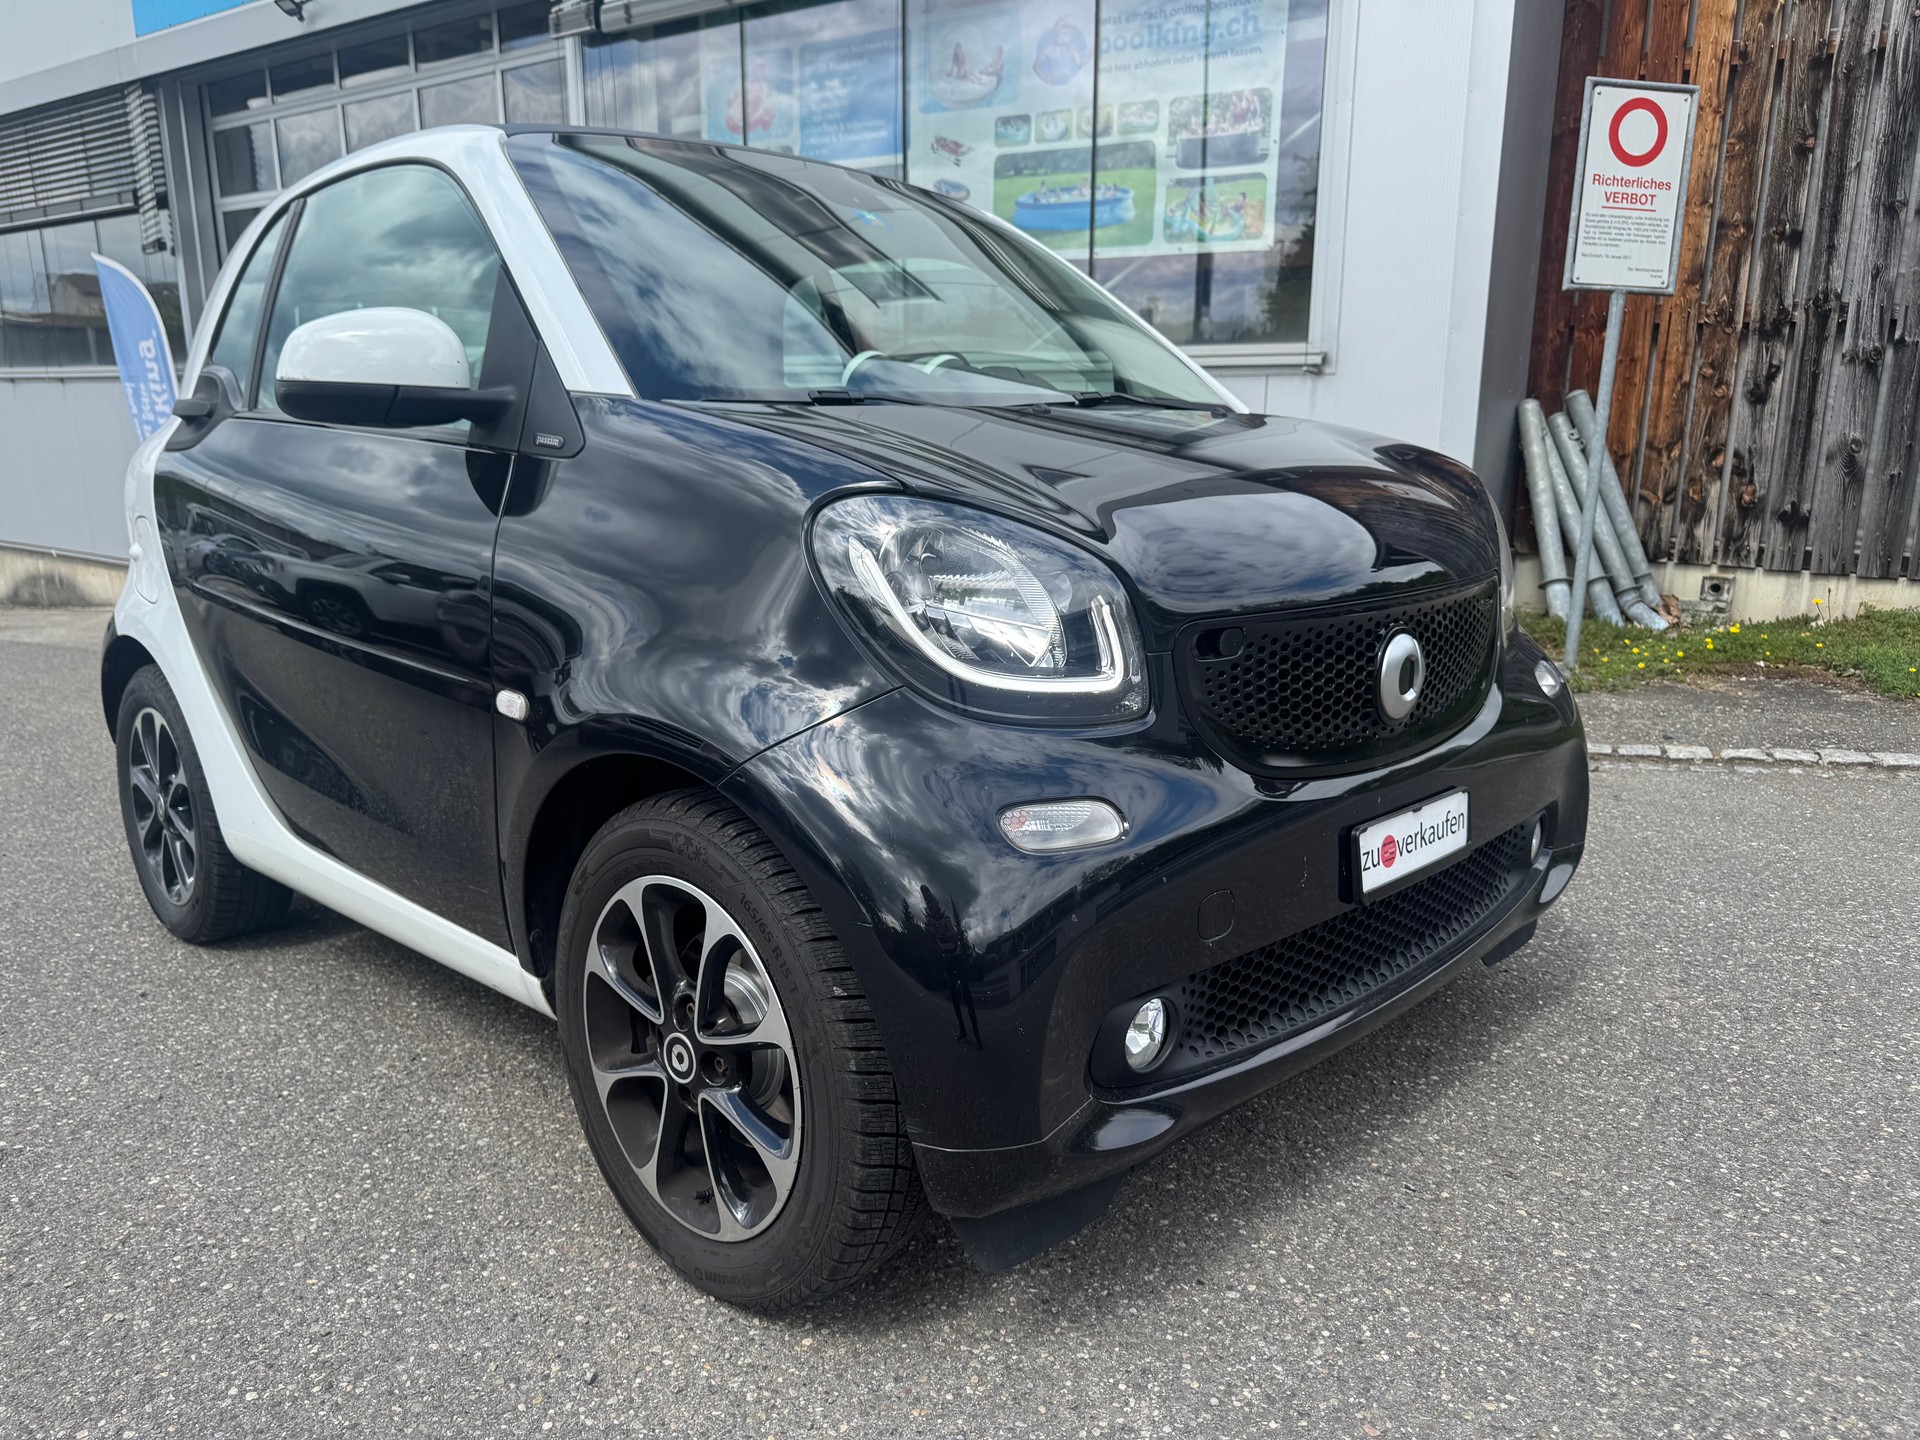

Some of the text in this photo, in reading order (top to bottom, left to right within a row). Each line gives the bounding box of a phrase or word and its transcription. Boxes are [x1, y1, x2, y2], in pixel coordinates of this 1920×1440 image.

[1592, 173, 1672, 191] Richterliches
[1604, 191, 1657, 206] VERBOT
[1362, 847, 1381, 872] zu
[1396, 810, 1465, 857] verkaufen
[739, 893, 775, 944] 165/65
[771, 945, 793, 980] R15
